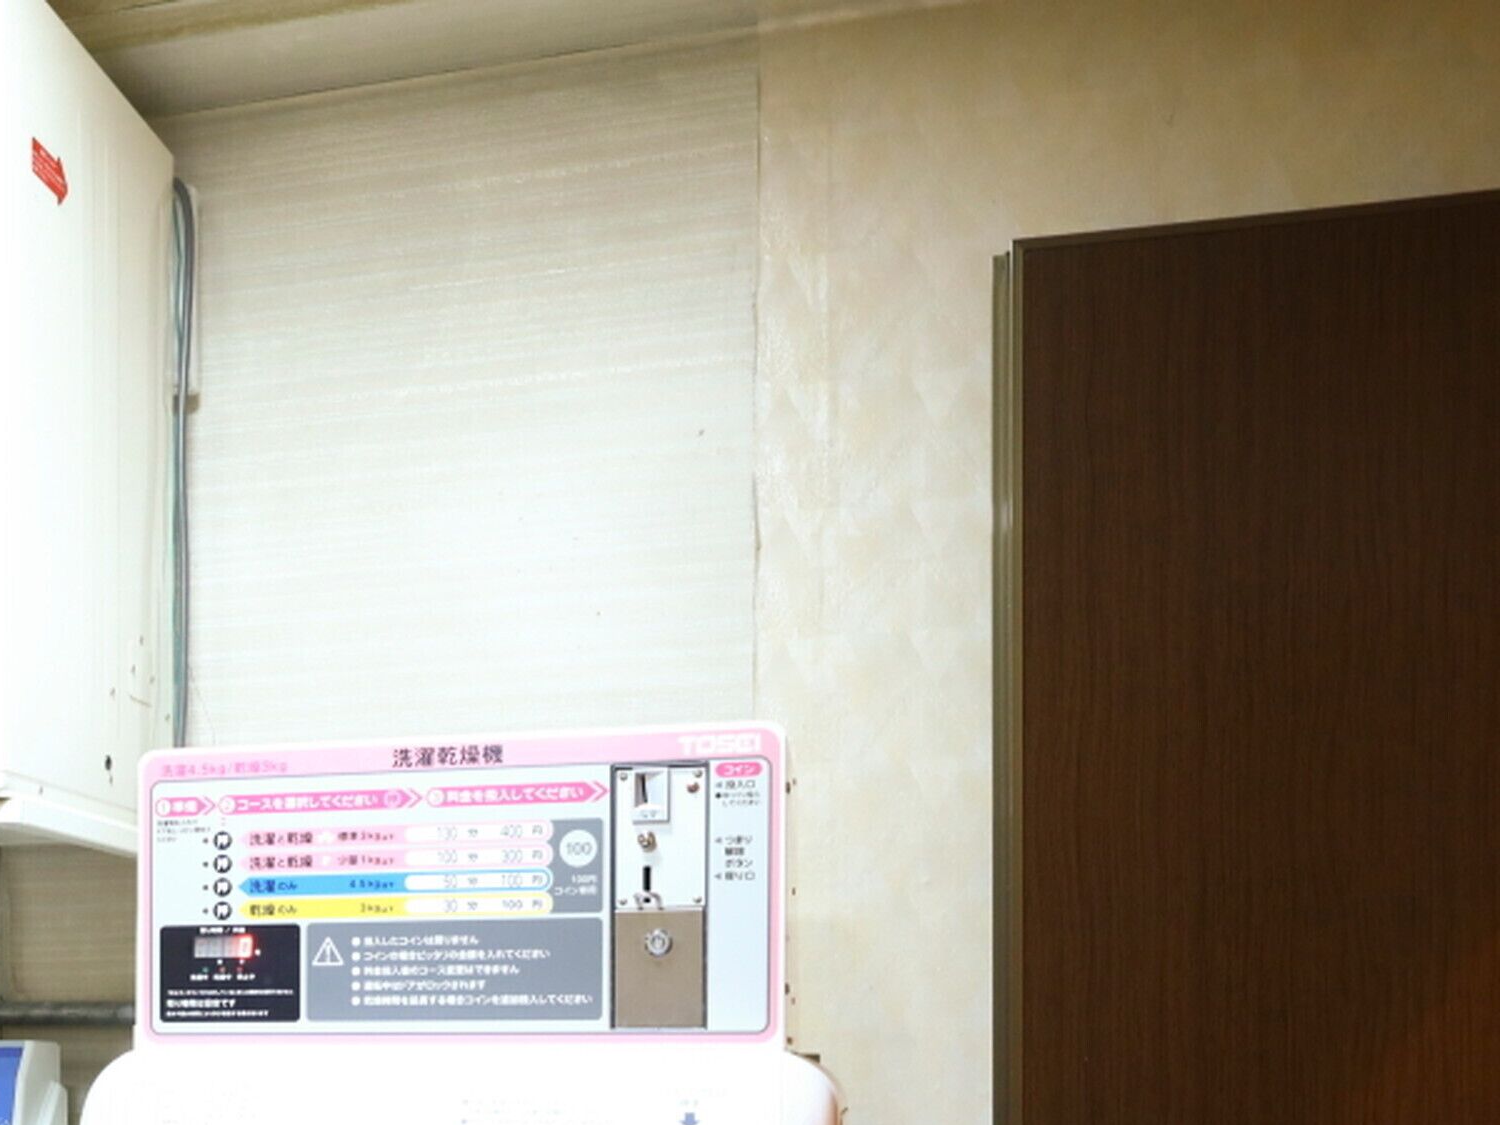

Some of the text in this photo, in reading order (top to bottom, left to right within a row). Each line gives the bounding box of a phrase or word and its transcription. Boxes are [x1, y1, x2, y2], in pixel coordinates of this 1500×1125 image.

[392, 744, 505, 768] 洗濯乾燥機
[723, 764, 755, 776] コイン
[249, 832, 313, 846] 洗濯と乾燥
[500, 824, 523, 839] 400
[566, 842, 593, 855] 100
[249, 855, 313, 869] 洗濯と乾燥
[500, 849, 523, 863] 300
[249, 880, 298, 893] 洗濯のみ
[501, 873, 523, 887] 100
[249, 903, 297, 916] 乾燥のみ
[501, 899, 523, 909] 100
